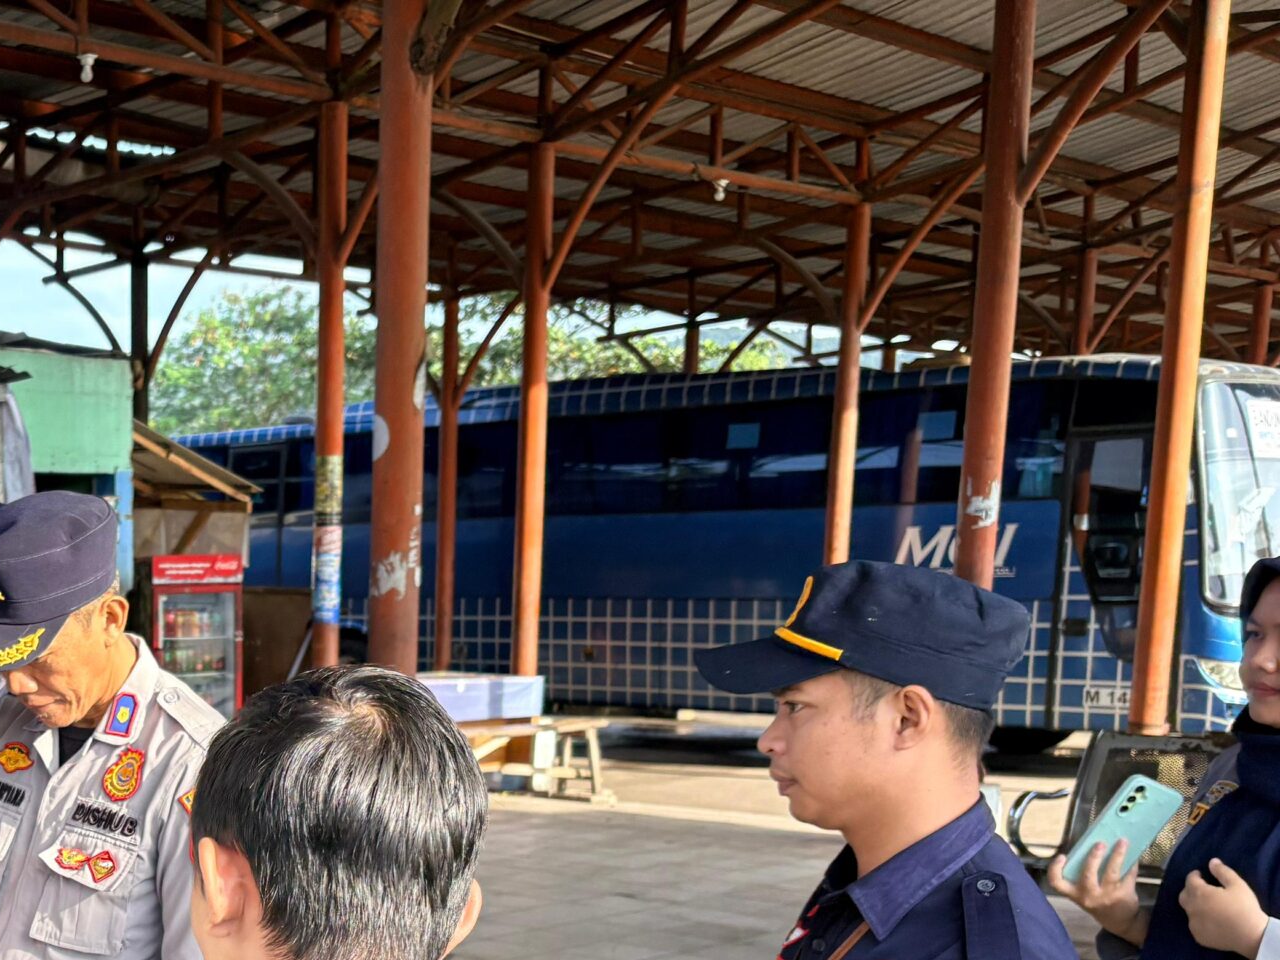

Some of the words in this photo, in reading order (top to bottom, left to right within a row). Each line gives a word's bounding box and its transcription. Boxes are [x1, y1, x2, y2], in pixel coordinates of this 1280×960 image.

[894, 522, 1019, 569] MI
[1085, 690, 1100, 704] M
[71, 802, 137, 837] DISHUB
